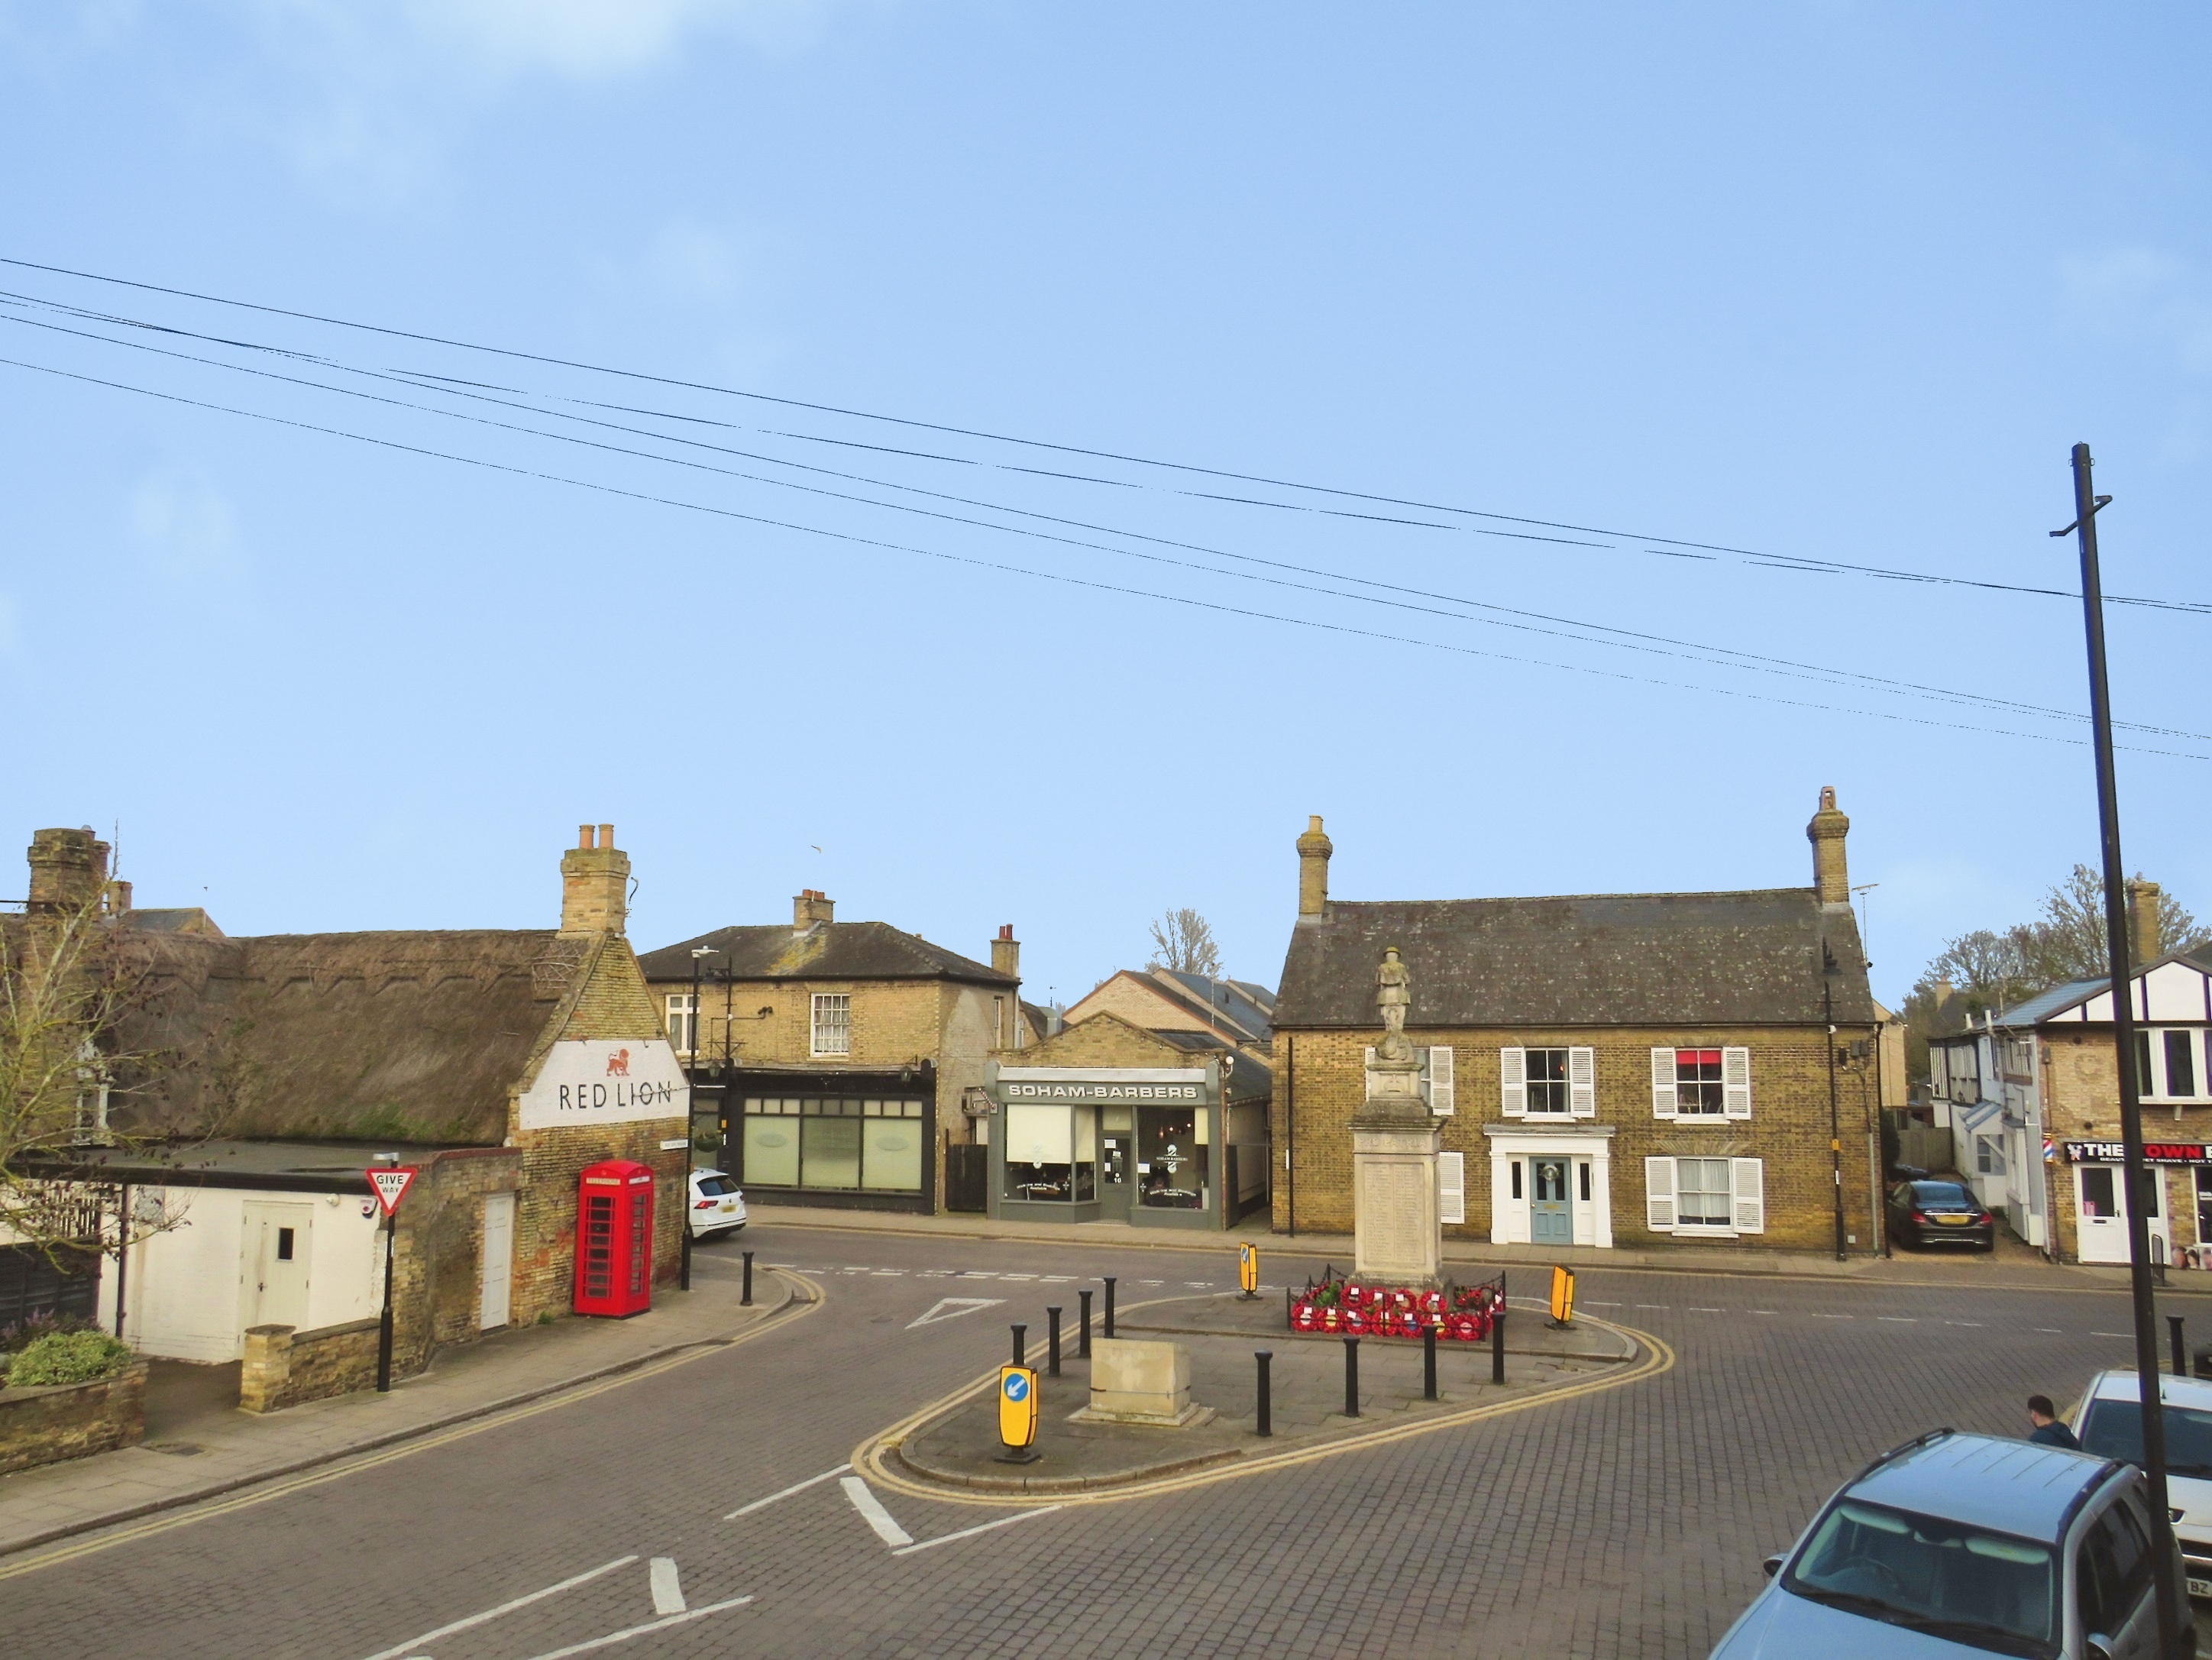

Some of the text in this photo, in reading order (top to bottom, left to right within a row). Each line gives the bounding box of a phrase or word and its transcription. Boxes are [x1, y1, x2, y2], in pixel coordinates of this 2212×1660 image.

[560, 1081, 671, 1110] RED LION
[1360, 1137, 1426, 1147] PRO PATRIA
[2083, 1144, 2124, 1157] THE
[2144, 1144, 2202, 1159] OWN
[377, 1175, 403, 1184] GIVE
